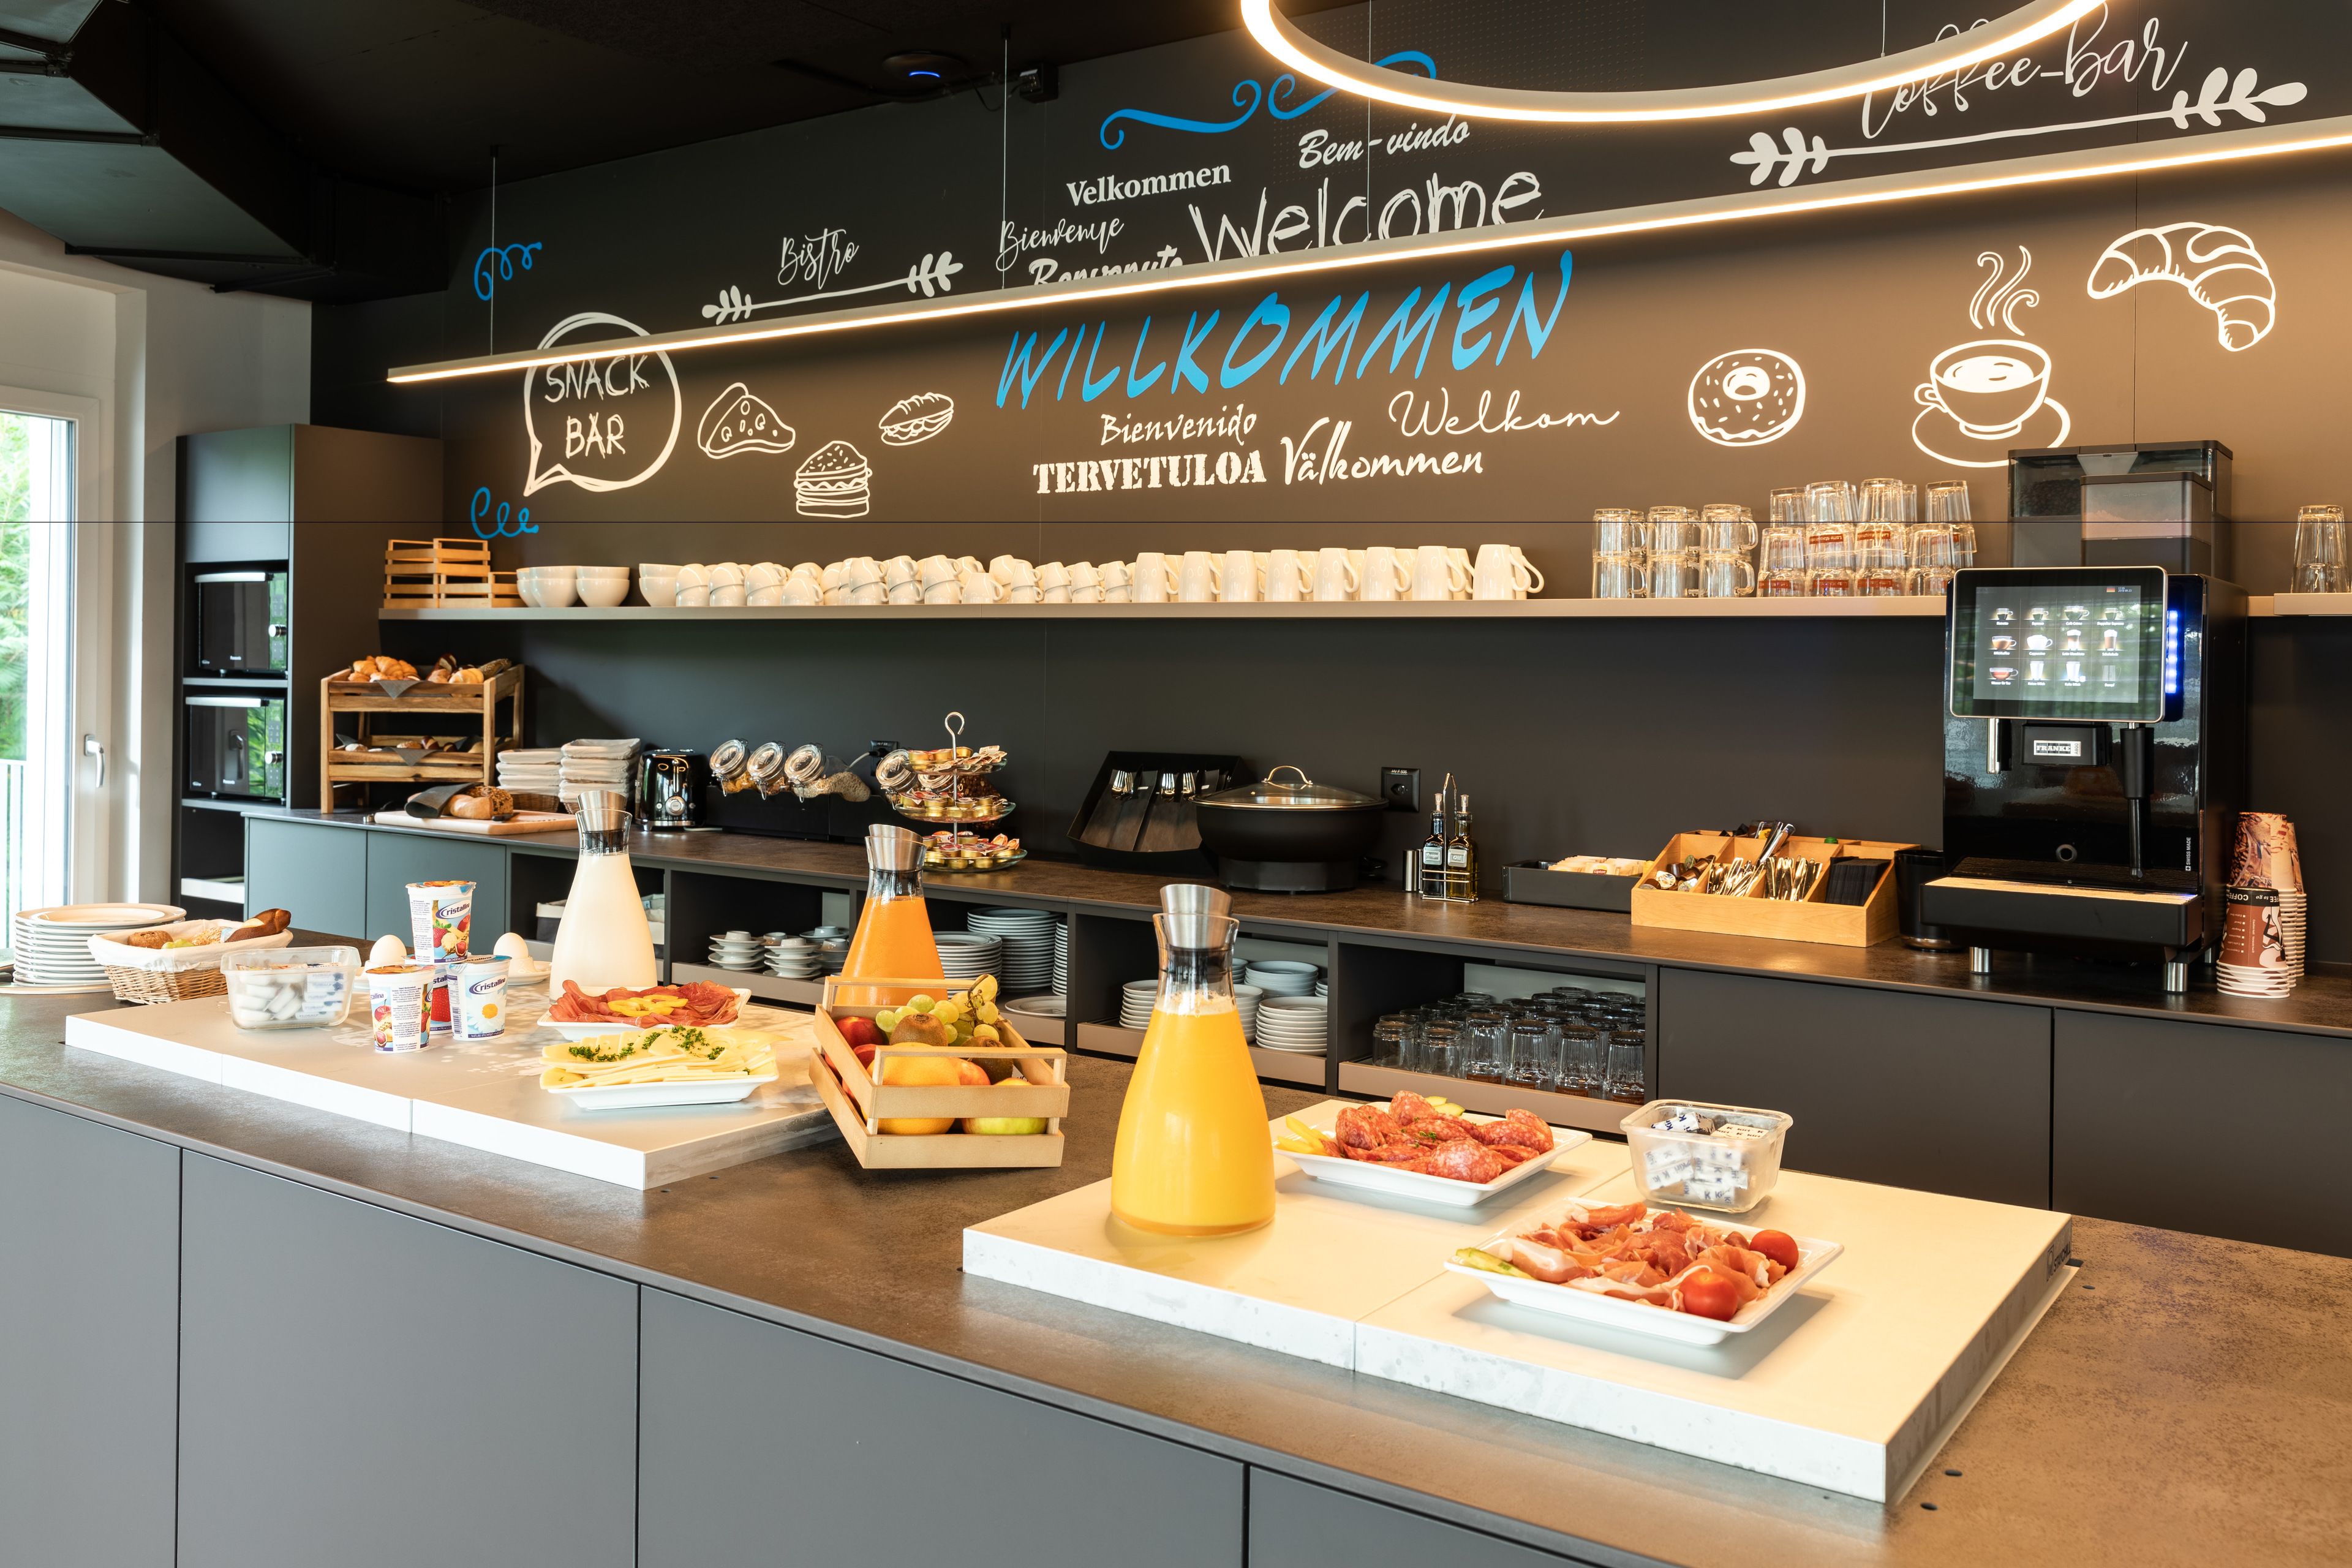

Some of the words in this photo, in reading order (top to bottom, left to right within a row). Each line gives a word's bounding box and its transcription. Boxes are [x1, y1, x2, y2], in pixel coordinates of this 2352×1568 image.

[1066, 164, 1231, 206] Velkommen
[1189, 171, 1544, 262] Welcome
[778, 228, 859, 290] Bistro
[996, 249, 1573, 409] WILLKOMMEN
[545, 355, 649, 403] SNACK
[565, 412, 626, 459] BAR
[1101, 403, 1257, 448] Bienvenido
[1388, 387, 1621, 437] Welkom
[1033, 450, 1267, 494] TERVETULOA
[1280, 417, 1484, 486] Välkommen
